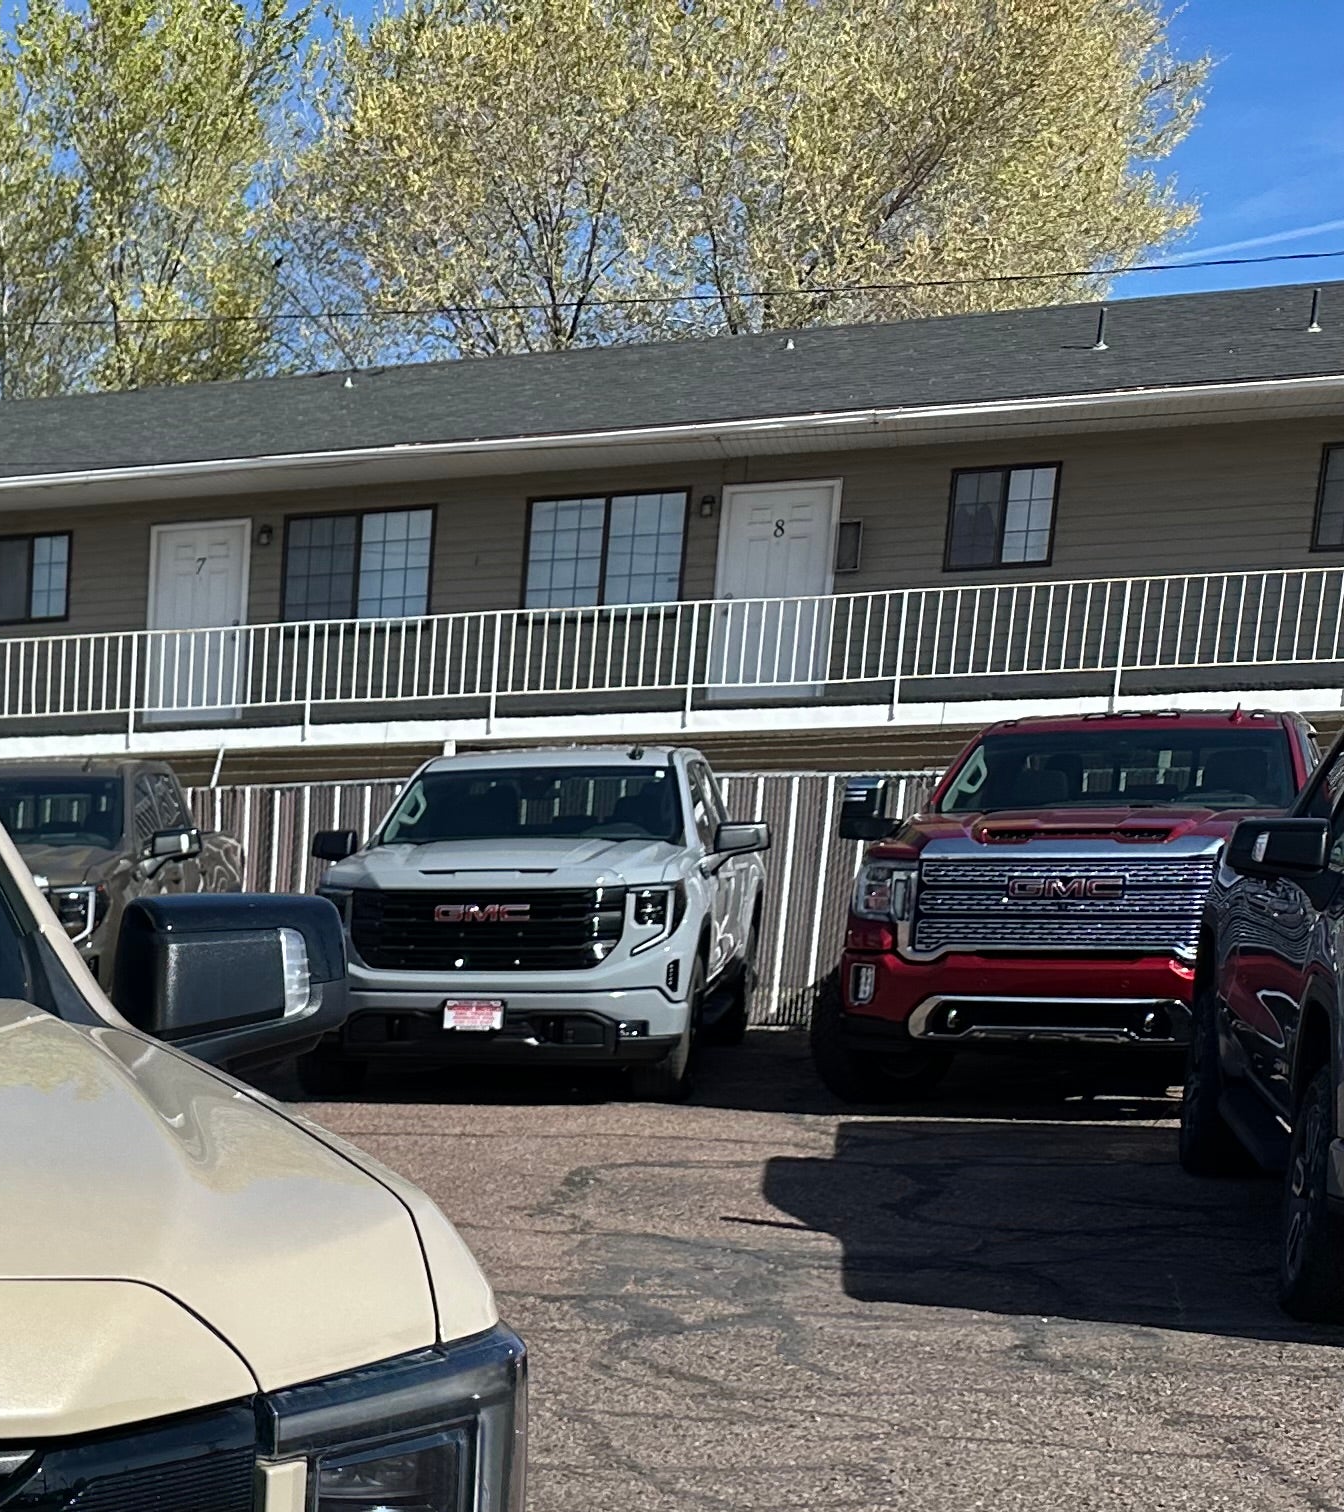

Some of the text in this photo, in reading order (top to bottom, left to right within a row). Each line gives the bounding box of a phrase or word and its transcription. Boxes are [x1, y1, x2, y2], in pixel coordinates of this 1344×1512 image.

[773, 519, 785, 538] 8
[196, 557, 207, 575] 7
[1009, 878, 1123, 897] GMC
[435, 904, 531, 922] GMC
